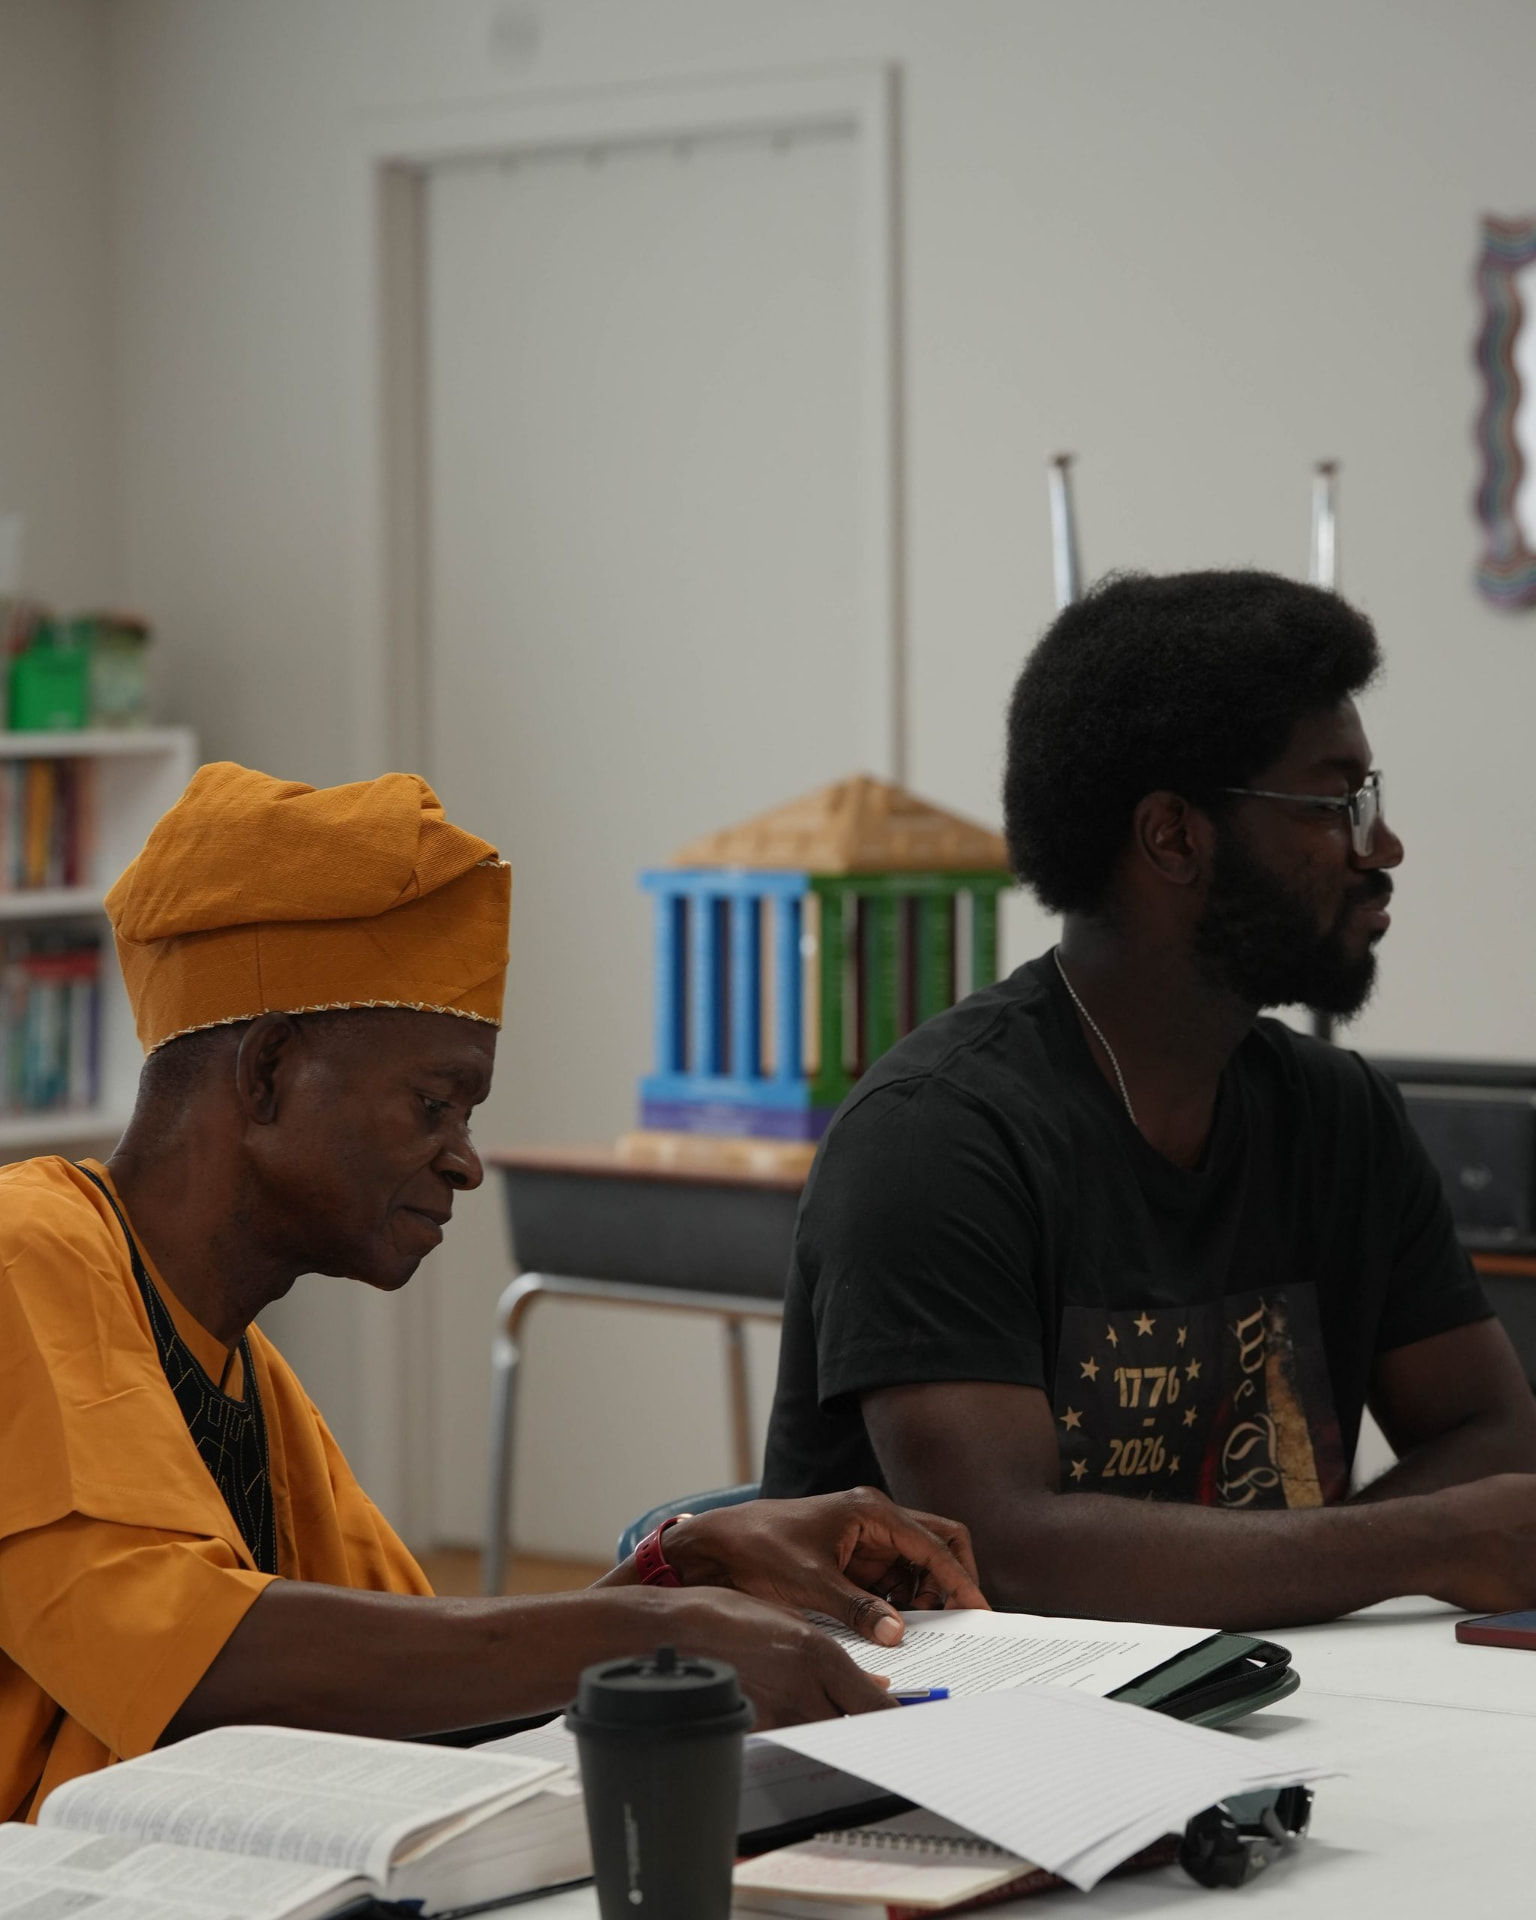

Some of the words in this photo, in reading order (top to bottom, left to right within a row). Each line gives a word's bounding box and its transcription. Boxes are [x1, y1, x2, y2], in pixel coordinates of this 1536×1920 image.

[1114, 1366, 1180, 1408] 1776
[1228, 1296, 1268, 1411] We
[1102, 1435, 1166, 1478] 2026
[1217, 1412, 1284, 1507] Th
